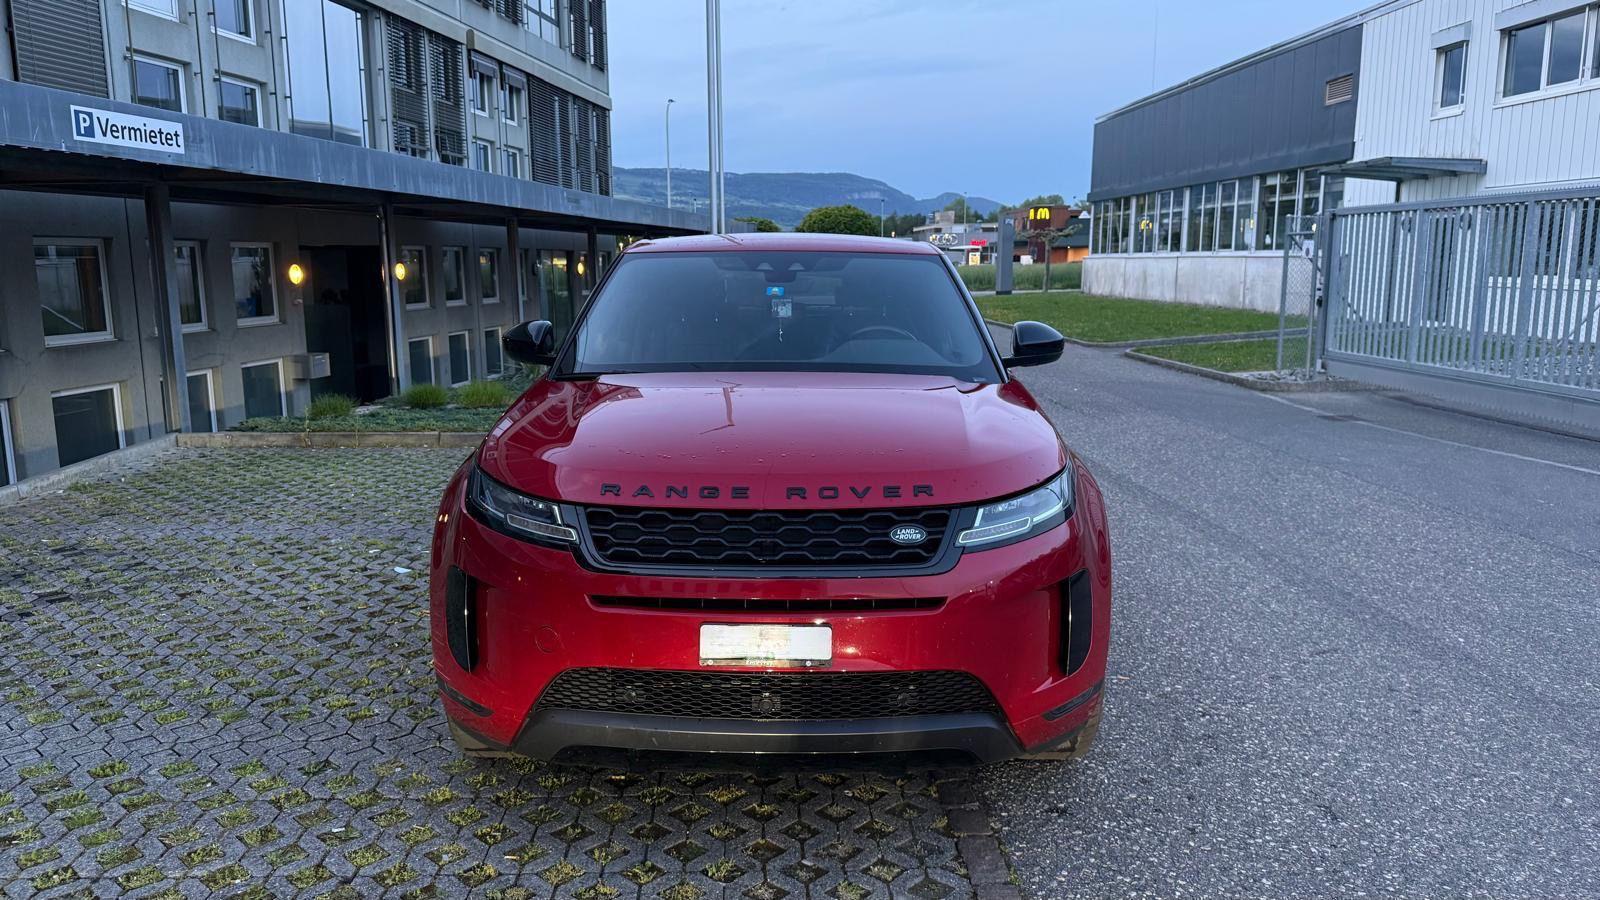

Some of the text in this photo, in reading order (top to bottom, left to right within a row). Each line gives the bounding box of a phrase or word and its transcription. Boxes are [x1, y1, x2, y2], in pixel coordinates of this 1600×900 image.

[79, 113, 181, 147] P Vermietet
[600, 483, 934, 500] RANGE ROVER
